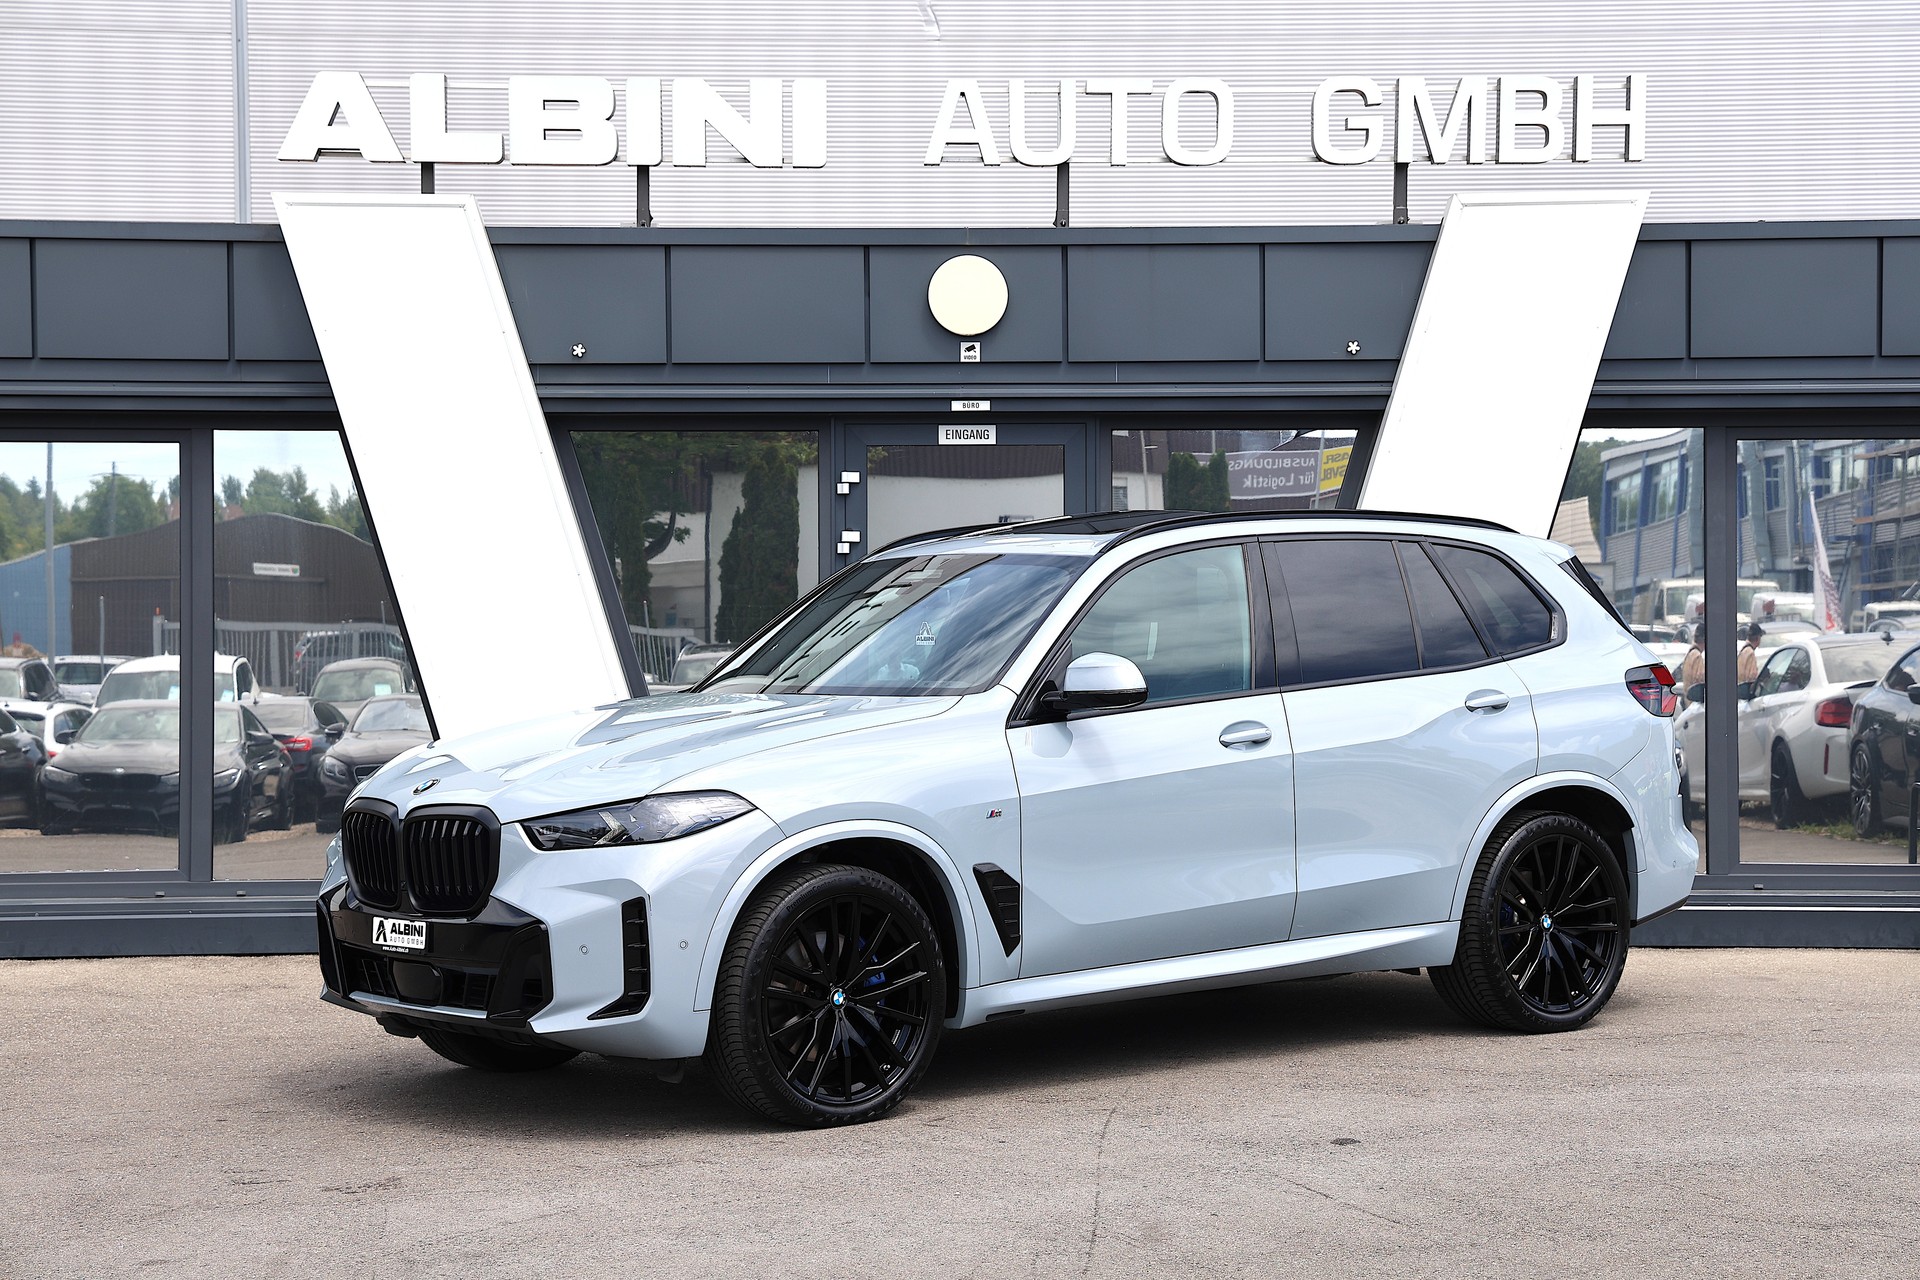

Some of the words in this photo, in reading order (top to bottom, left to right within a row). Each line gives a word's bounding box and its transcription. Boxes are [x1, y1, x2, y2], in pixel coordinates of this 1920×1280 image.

[277, 71, 828, 168] ALBINI
[923, 77, 1234, 166] AUTO
[1310, 74, 1647, 165] GMBH
[962, 401, 980, 409] BÜRO
[945, 429, 990, 440] EINGANG
[390, 922, 424, 938] ALBINI
